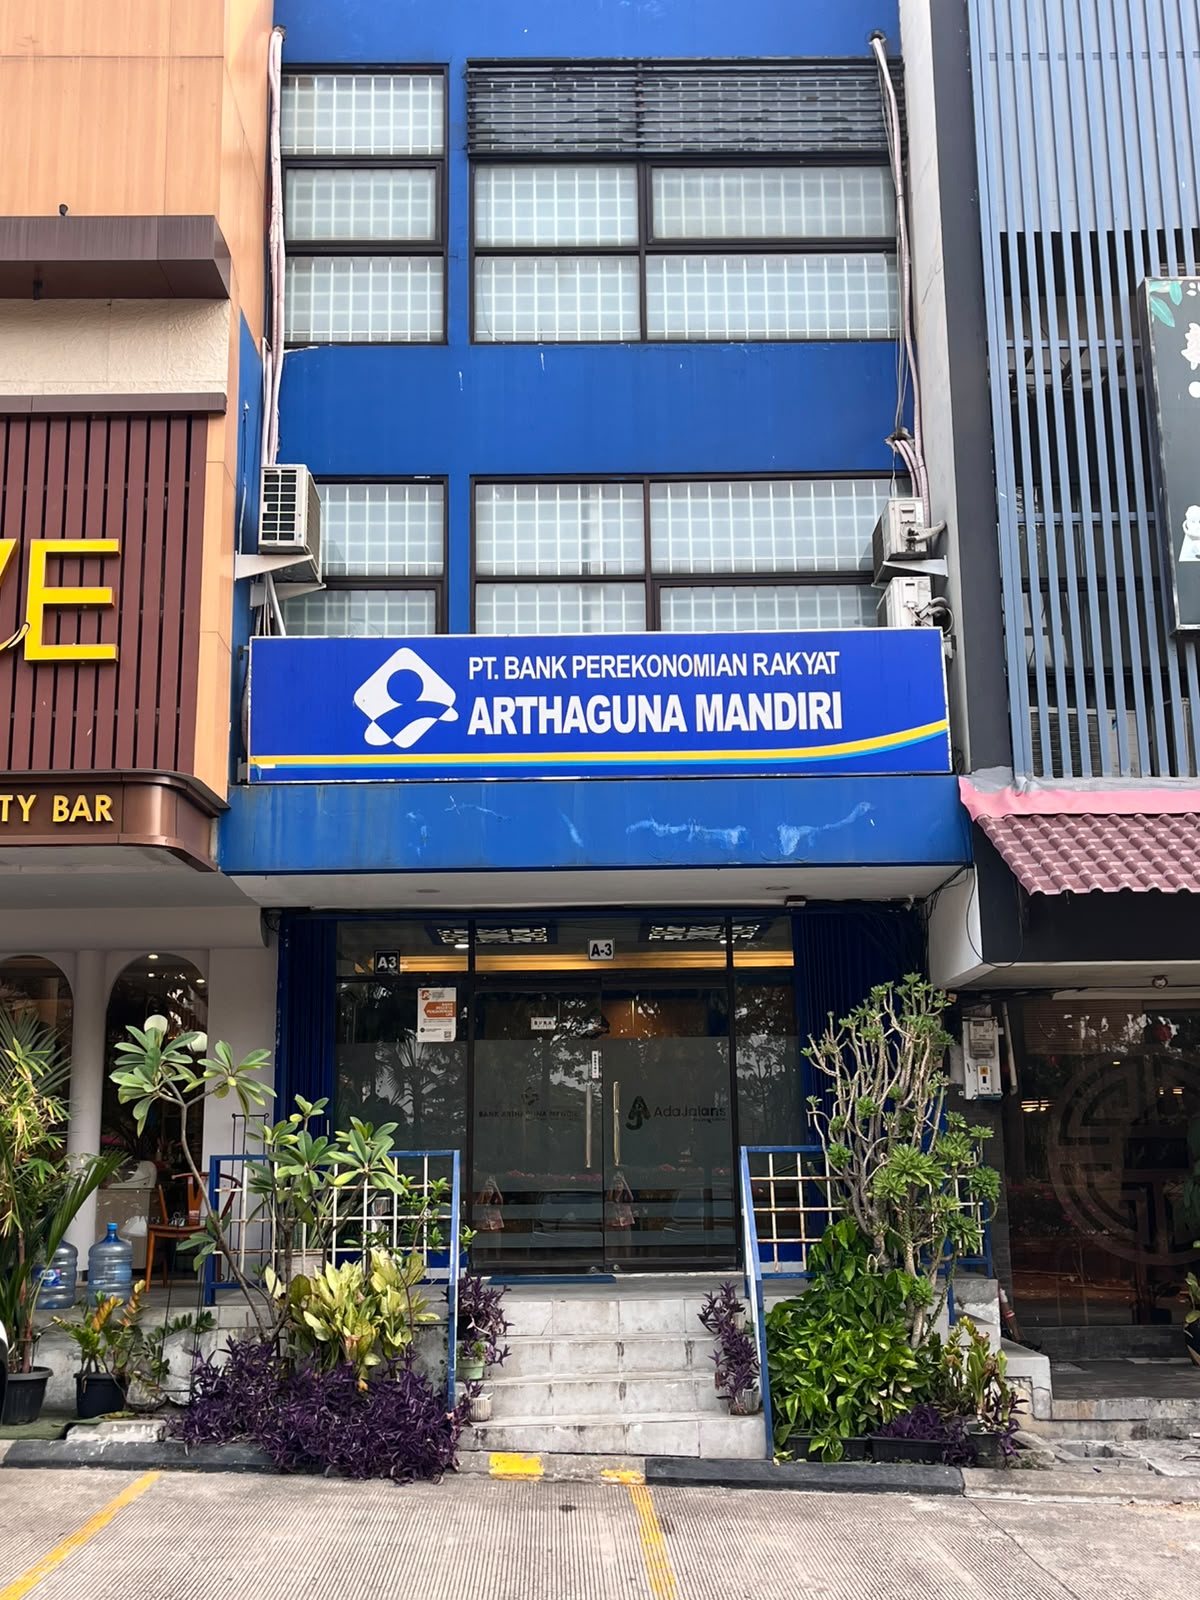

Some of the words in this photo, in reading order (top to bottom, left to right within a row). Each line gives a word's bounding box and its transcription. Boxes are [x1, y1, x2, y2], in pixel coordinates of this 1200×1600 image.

[0, 538, 120, 661] E
[469, 656, 499, 680] PT.
[504, 655, 568, 680] BANK
[572, 653, 747, 679] PEREKONOMIAN
[753, 651, 840, 676] RAKYAT
[467, 694, 688, 735] ARTHAGUNA
[695, 691, 843, 732] MANDIRI
[0, 794, 37, 822] TY
[52, 794, 114, 822] BAR
[377, 956, 397, 968] A3
[591, 943, 612, 956] A-3
